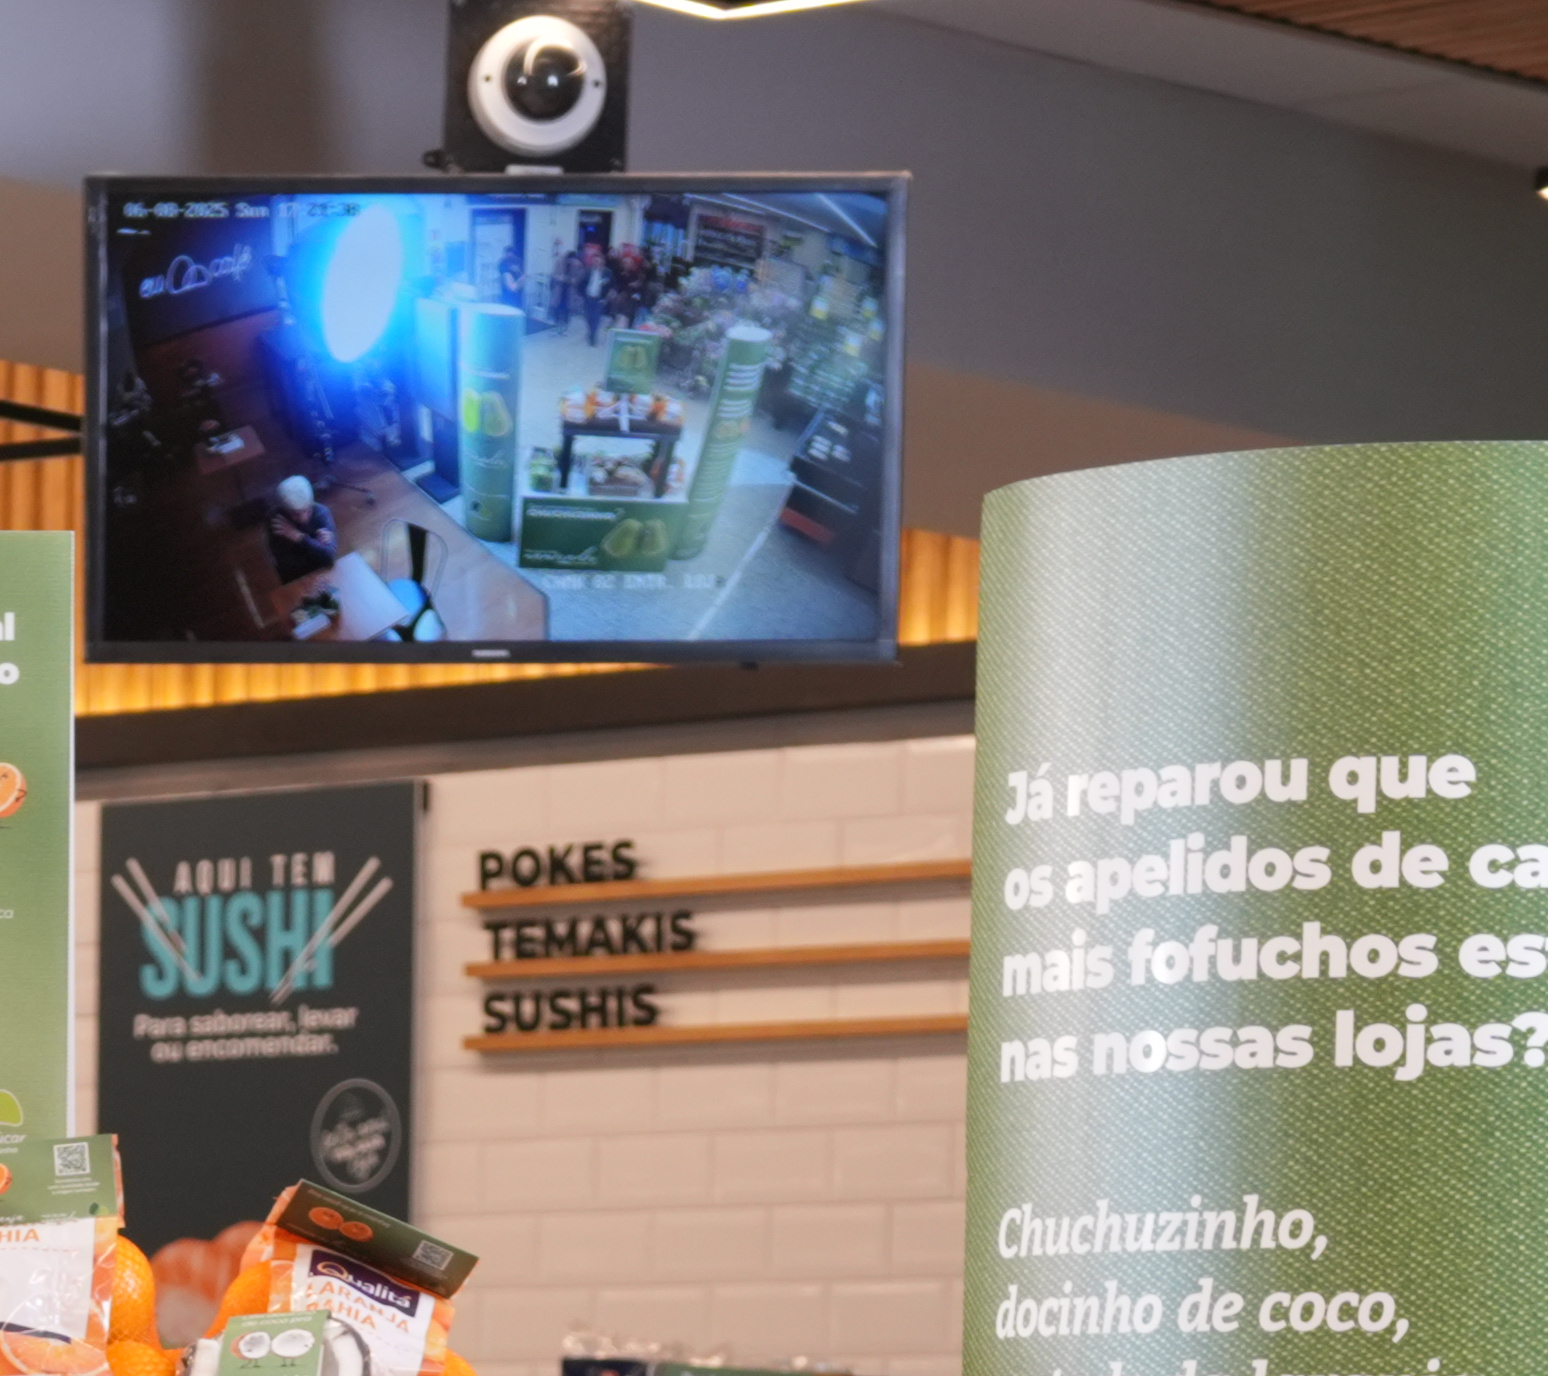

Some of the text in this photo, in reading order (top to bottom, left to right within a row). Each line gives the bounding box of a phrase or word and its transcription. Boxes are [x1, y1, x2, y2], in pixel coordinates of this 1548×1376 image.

[1004, 752, 1478, 825] Já reparou que
[174, 850, 335, 895] AQUI TEM
[479, 839, 638, 890] POKES
[1004, 861, 1054, 910] os
[1064, 831, 1333, 915] apelidos
[1351, 830, 1449, 889] de
[139, 887, 335, 1000] SUSHI
[484, 910, 697, 962] TEMAKIS
[1002, 928, 1114, 997] mais
[1127, 920, 1440, 987] fofuchos
[483, 985, 660, 1034] SUSHIS
[1000, 1032, 1079, 1083] nas
[1092, 1021, 1314, 1075] nossas
[997, 1193, 1329, 1261] Chuchuzinho,
[995, 1278, 1410, 1343] docinho de coco,
